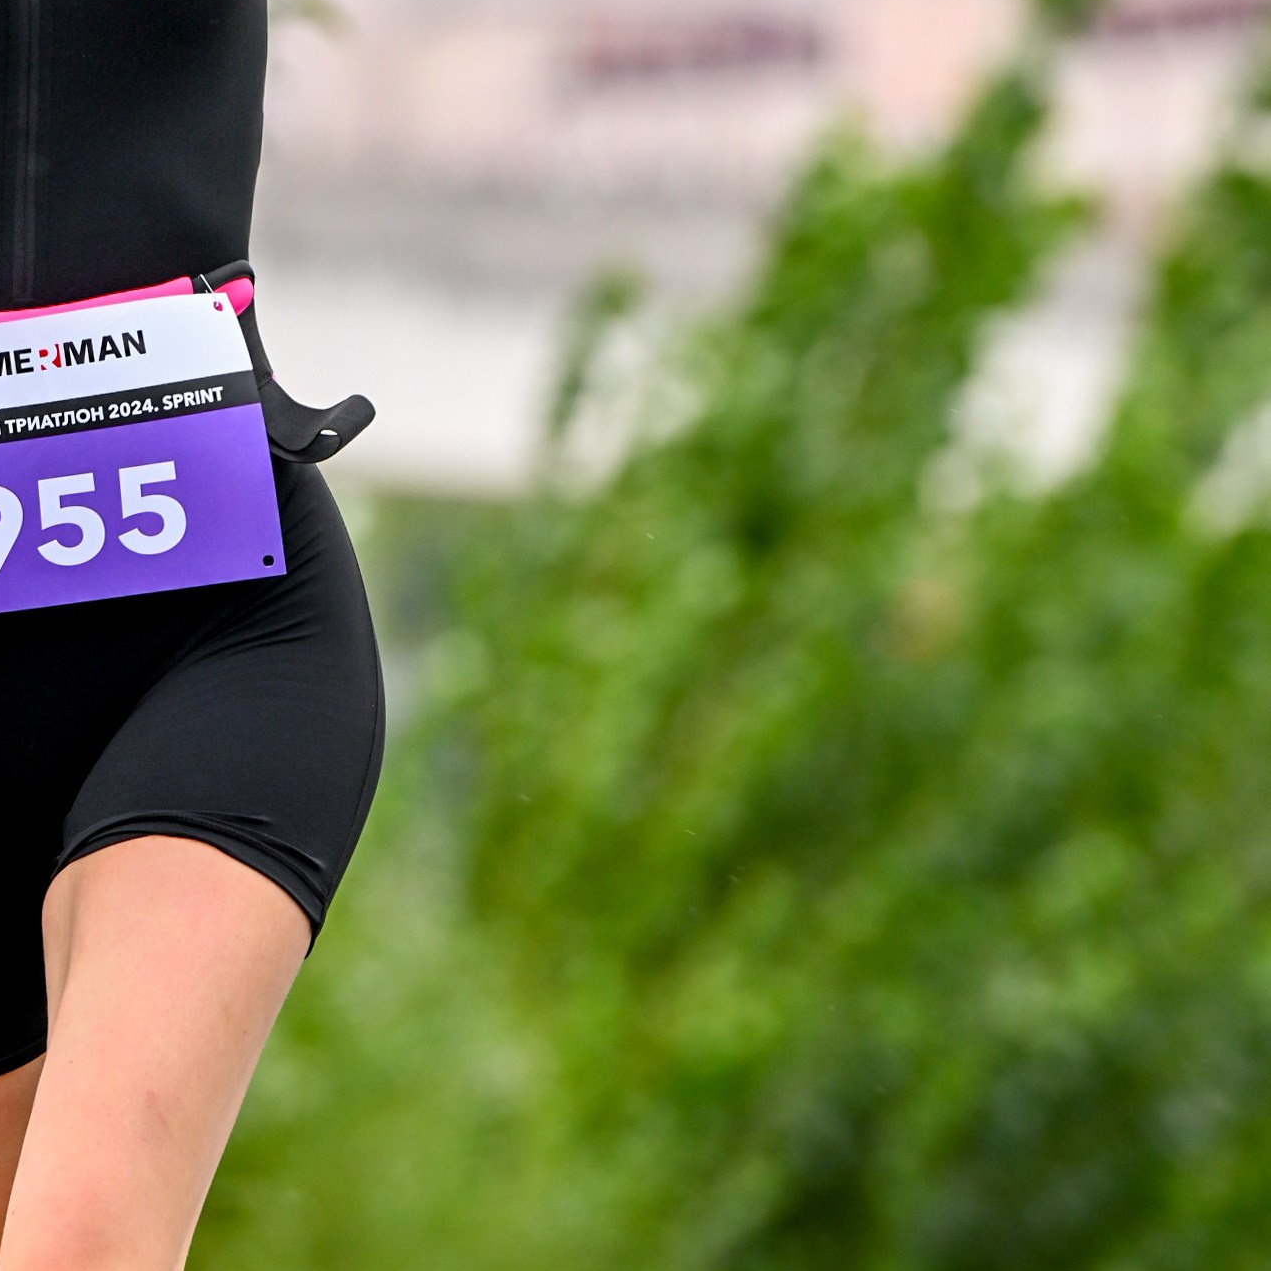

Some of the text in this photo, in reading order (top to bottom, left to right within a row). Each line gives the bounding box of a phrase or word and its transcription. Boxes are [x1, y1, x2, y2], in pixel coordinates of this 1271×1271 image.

[4, 405, 105, 434] ТРИАТЛОН
[107, 398, 159, 420] 2024.
[162, 385, 224, 411] SPRINT
